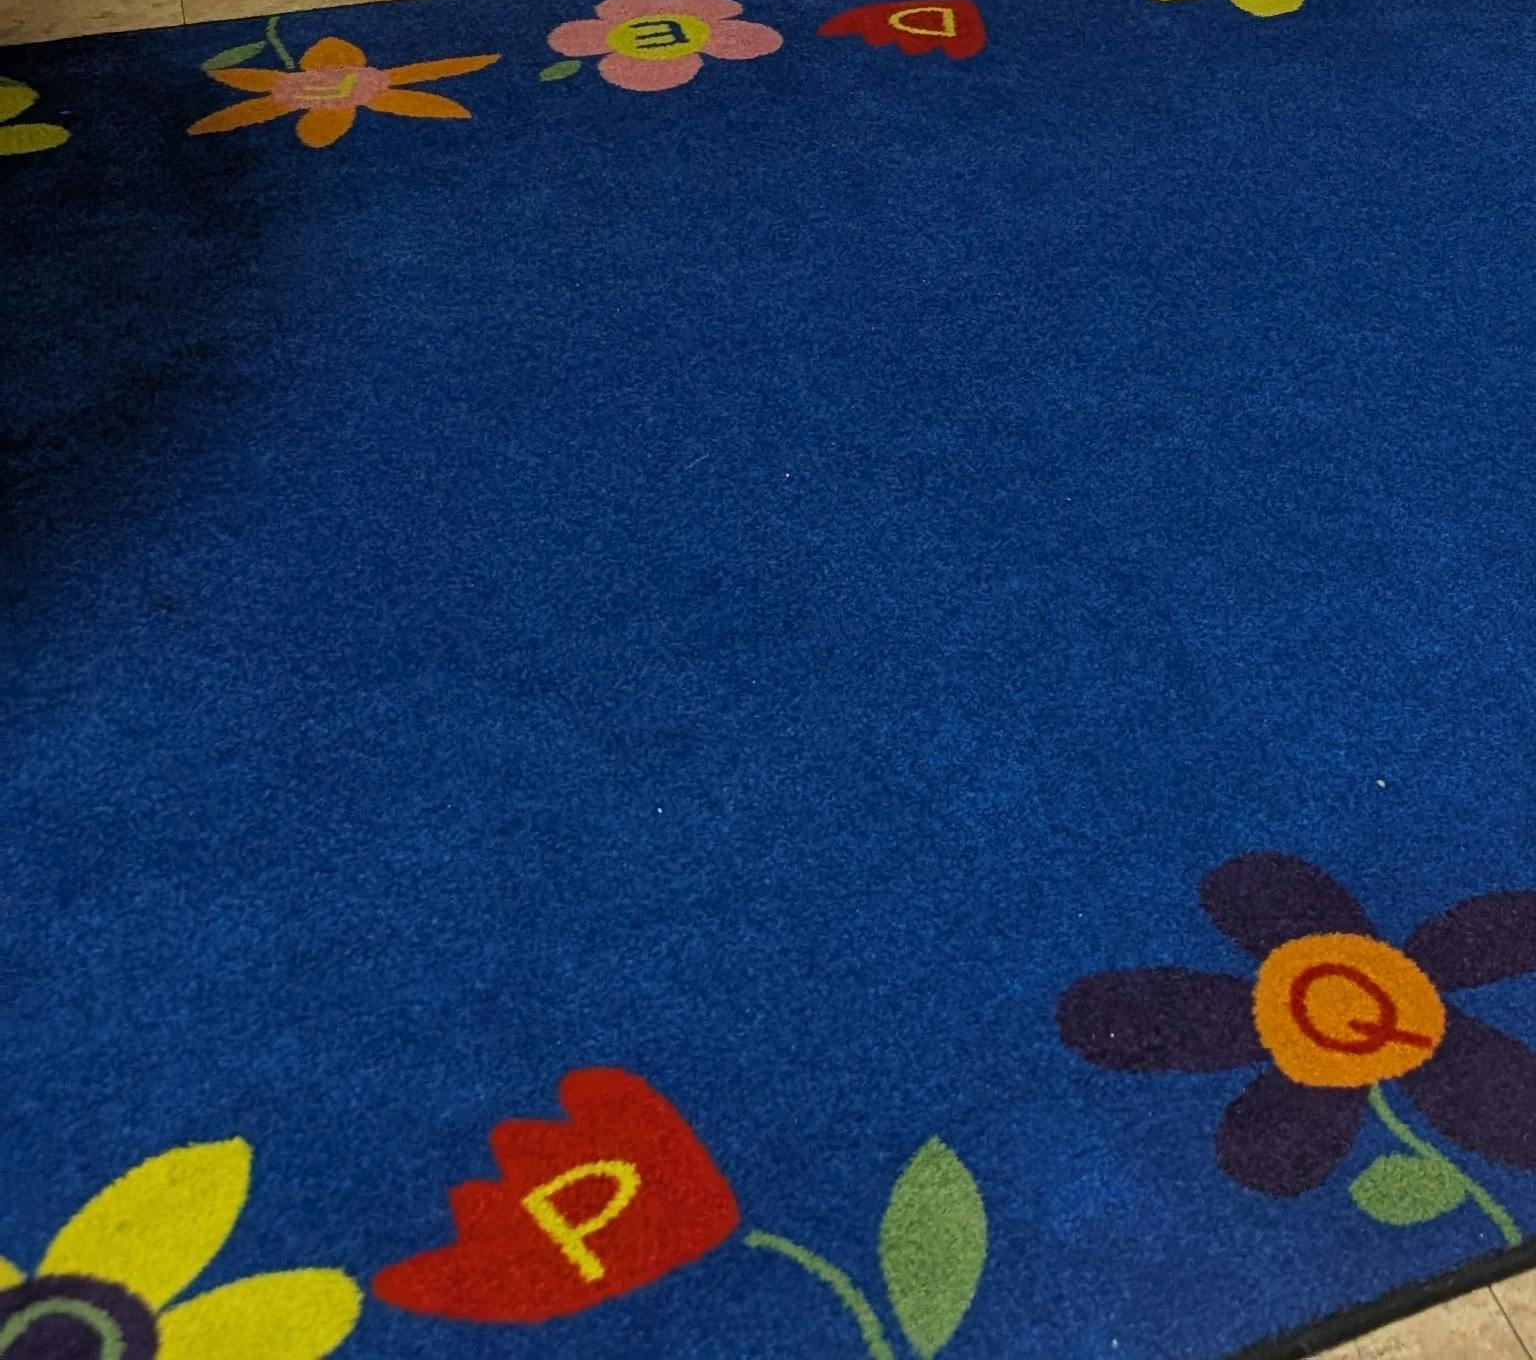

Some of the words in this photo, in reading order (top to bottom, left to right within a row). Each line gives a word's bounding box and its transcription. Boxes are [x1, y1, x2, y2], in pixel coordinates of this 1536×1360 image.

[628, 20, 690, 50] E
[889, 7, 956, 37] D
[1289, 962, 1434, 1055] Q
[521, 1160, 642, 1283] P
